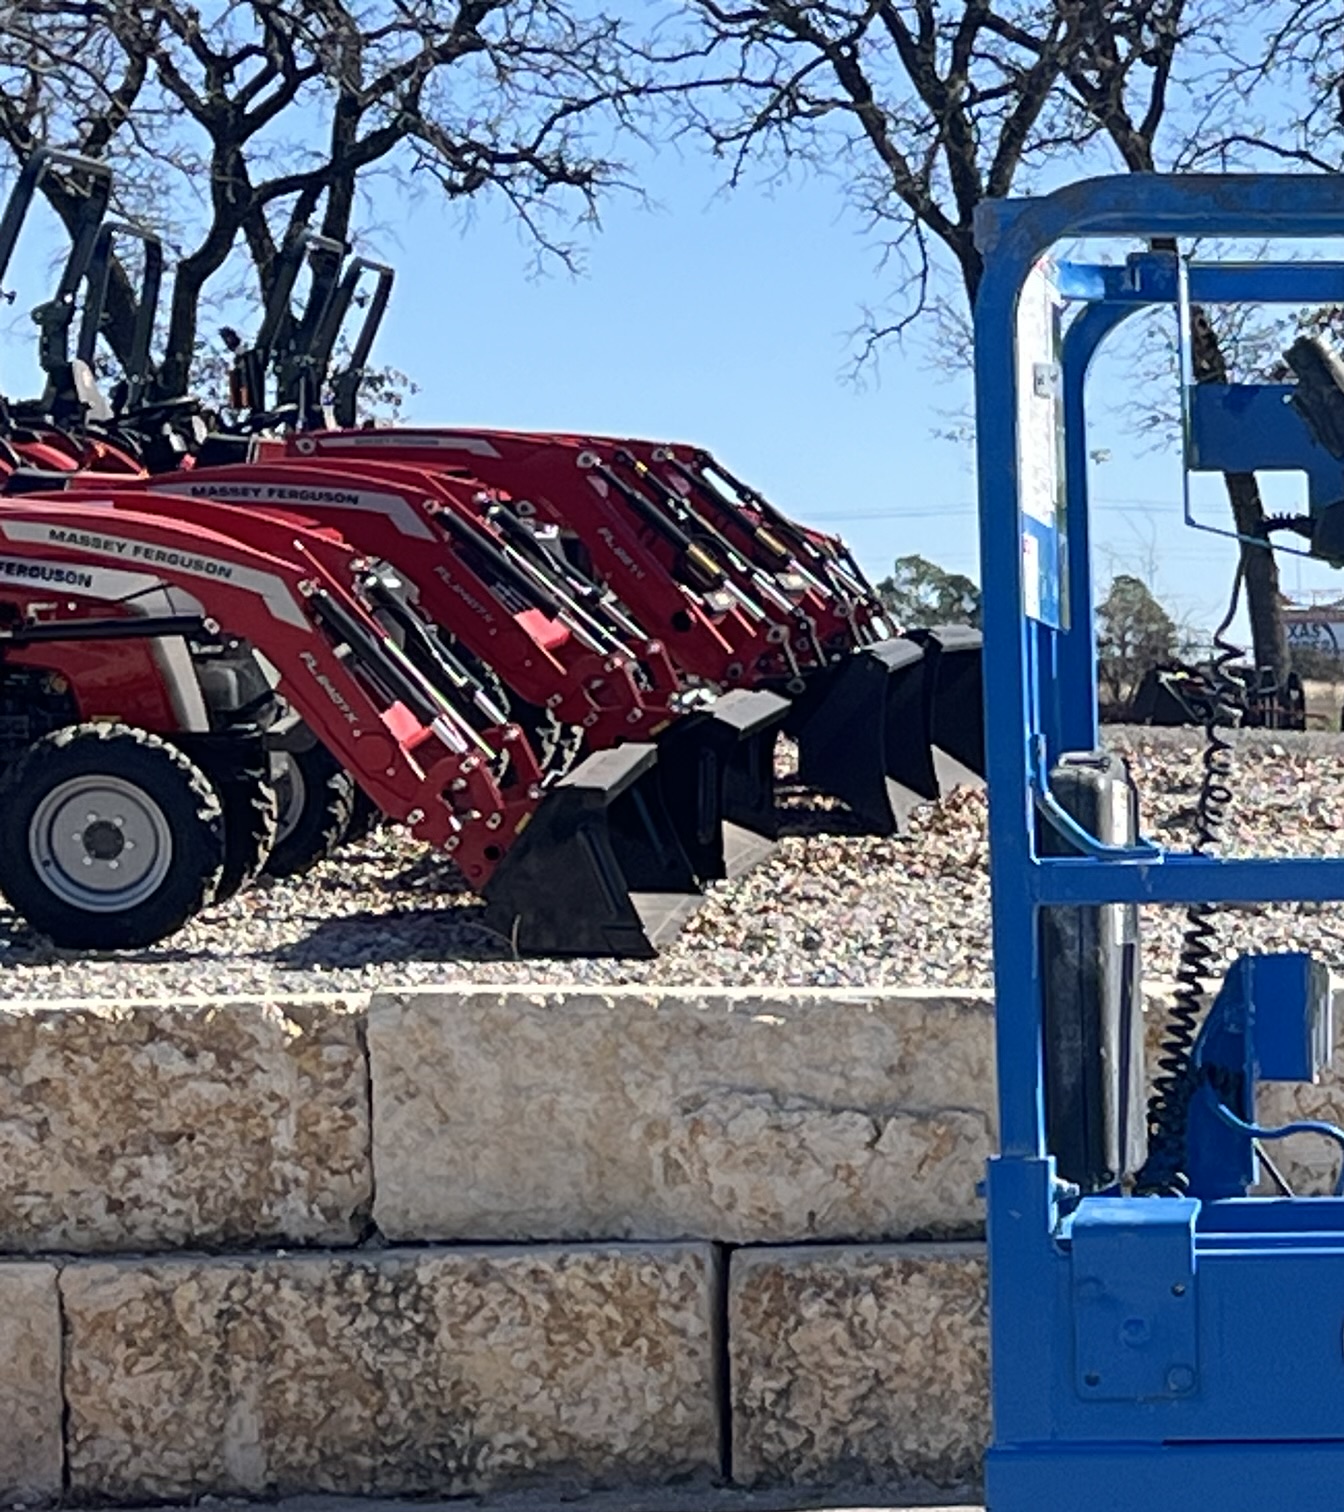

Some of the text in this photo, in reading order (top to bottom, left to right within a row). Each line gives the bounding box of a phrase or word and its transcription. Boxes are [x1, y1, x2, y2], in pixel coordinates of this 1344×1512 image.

[191, 485, 360, 506] MASSEY FERGUSON
[49, 528, 233, 580] MASSEY FERGUSON
[1287, 623, 1321, 639] XAS
